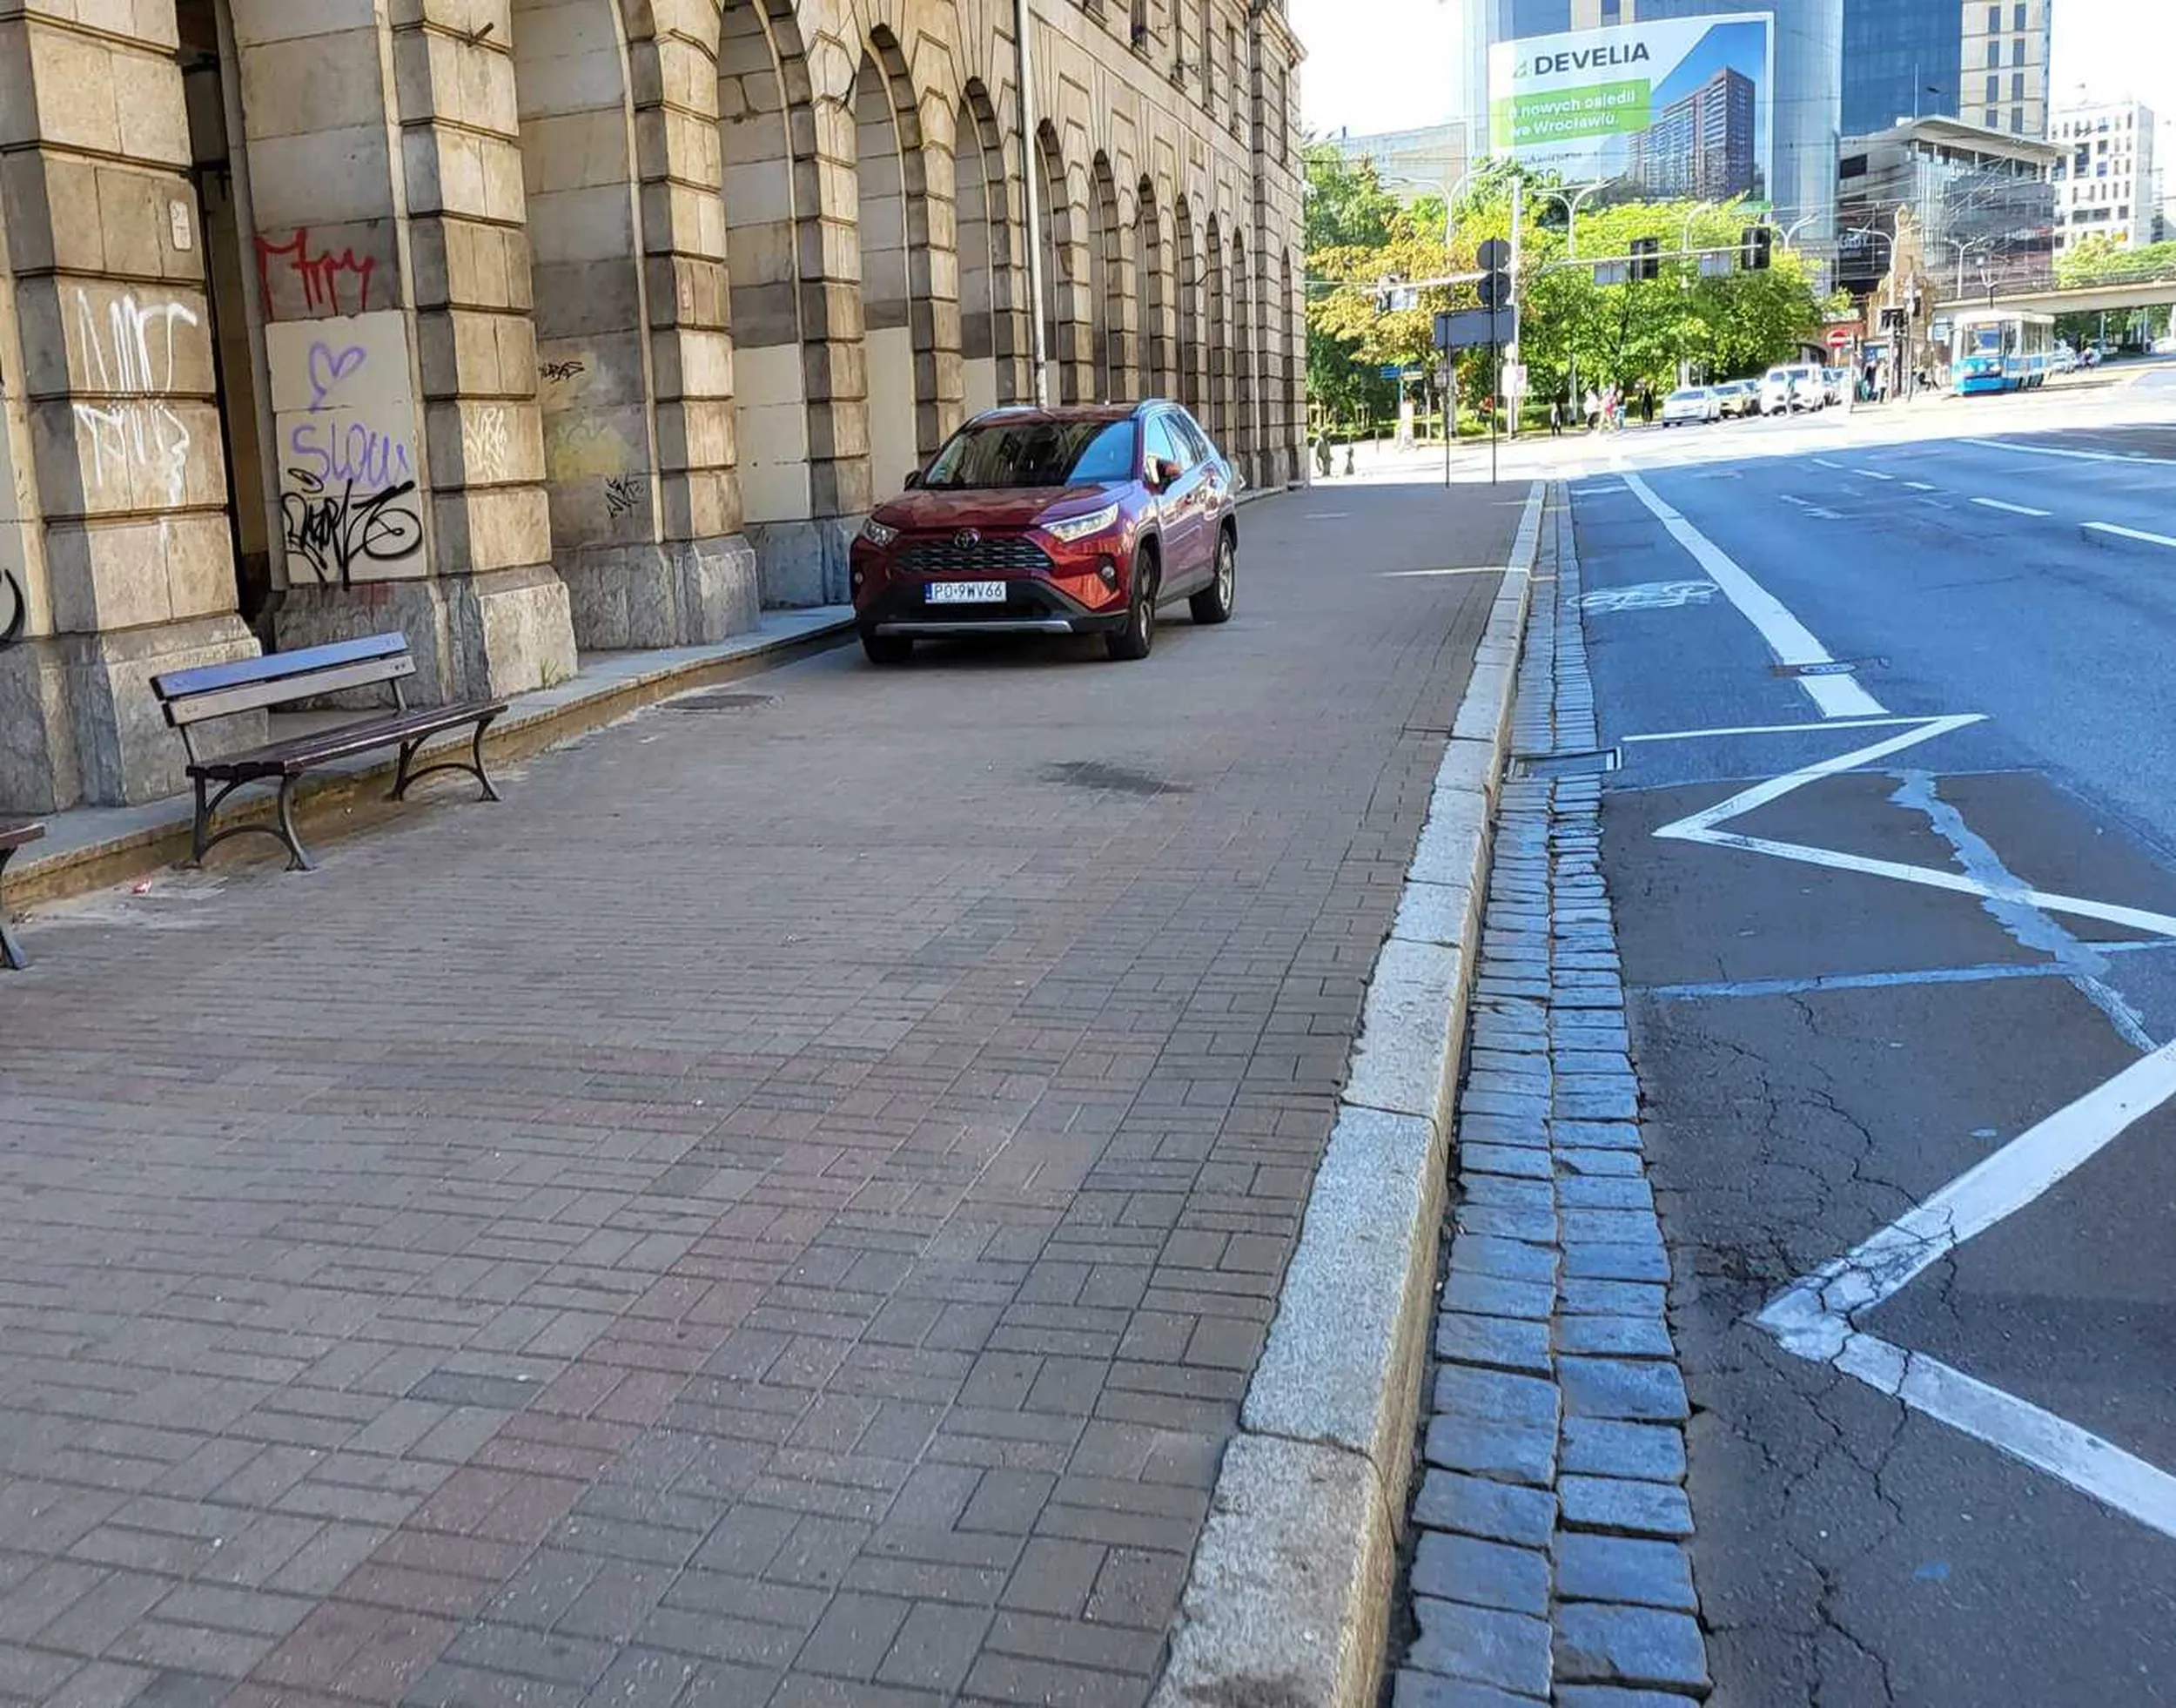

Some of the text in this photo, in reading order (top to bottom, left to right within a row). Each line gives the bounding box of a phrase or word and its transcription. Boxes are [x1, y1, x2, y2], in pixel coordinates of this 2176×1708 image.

[1535, 42, 1650, 76] DEVELIA
[1521, 98, 1581, 118] nowych
[1584, 89, 1635, 109] osiedli
